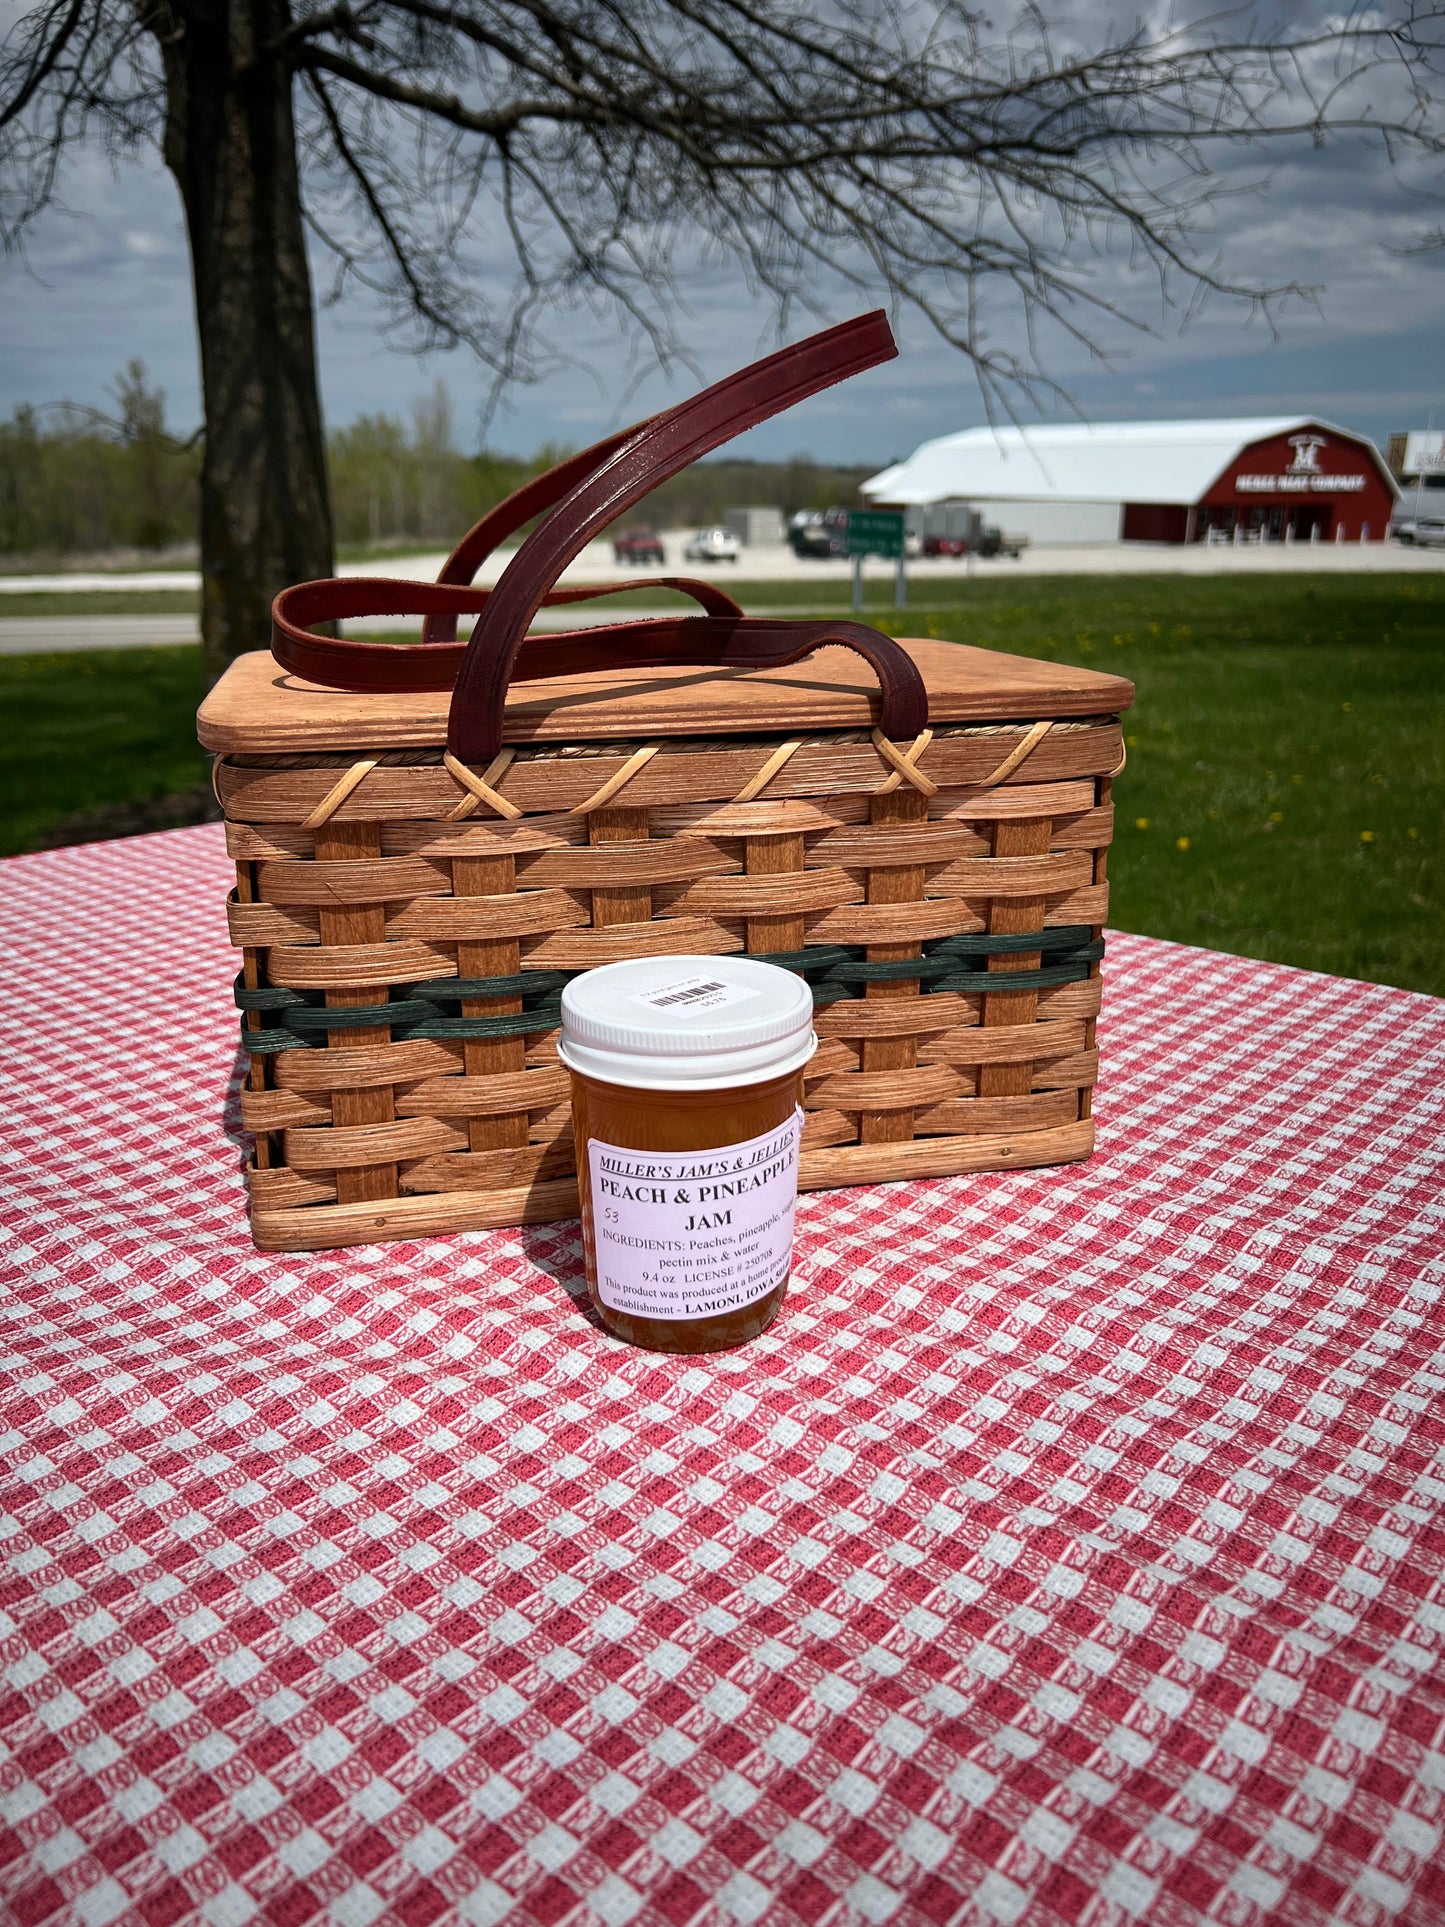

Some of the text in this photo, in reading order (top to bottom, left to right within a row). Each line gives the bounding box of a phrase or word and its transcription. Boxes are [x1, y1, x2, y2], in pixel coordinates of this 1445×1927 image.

[600, 1127, 795, 1178] MILLER'S JAM'S & JELLIES
[600, 1149, 795, 1204] PEACH & PINEAPPLE
[602, 1228, 686, 1251] INGREDIENTS:
[689, 1234, 736, 1251] Peaches,
[738, 1212, 780, 1242] pineapple,
[685, 1209, 732, 1231] JAM
[642, 1247, 774, 1284] 9.4 oz LICENSE # 250708
[659, 1240, 760, 1269] pectin mix & water
[604, 1276, 621, 1291] This
[622, 1282, 657, 1299] product
[660, 1290, 679, 1299] was
[682, 1282, 728, 1301] produced
[730, 1279, 739, 1290] at
[740, 1279, 746, 1287] a
[748, 1266, 769, 1285] home
[612, 1296, 675, 1315] establishment
[685, 1294, 744, 1315] LAMONI,
[746, 1277, 775, 1300] IOWA
